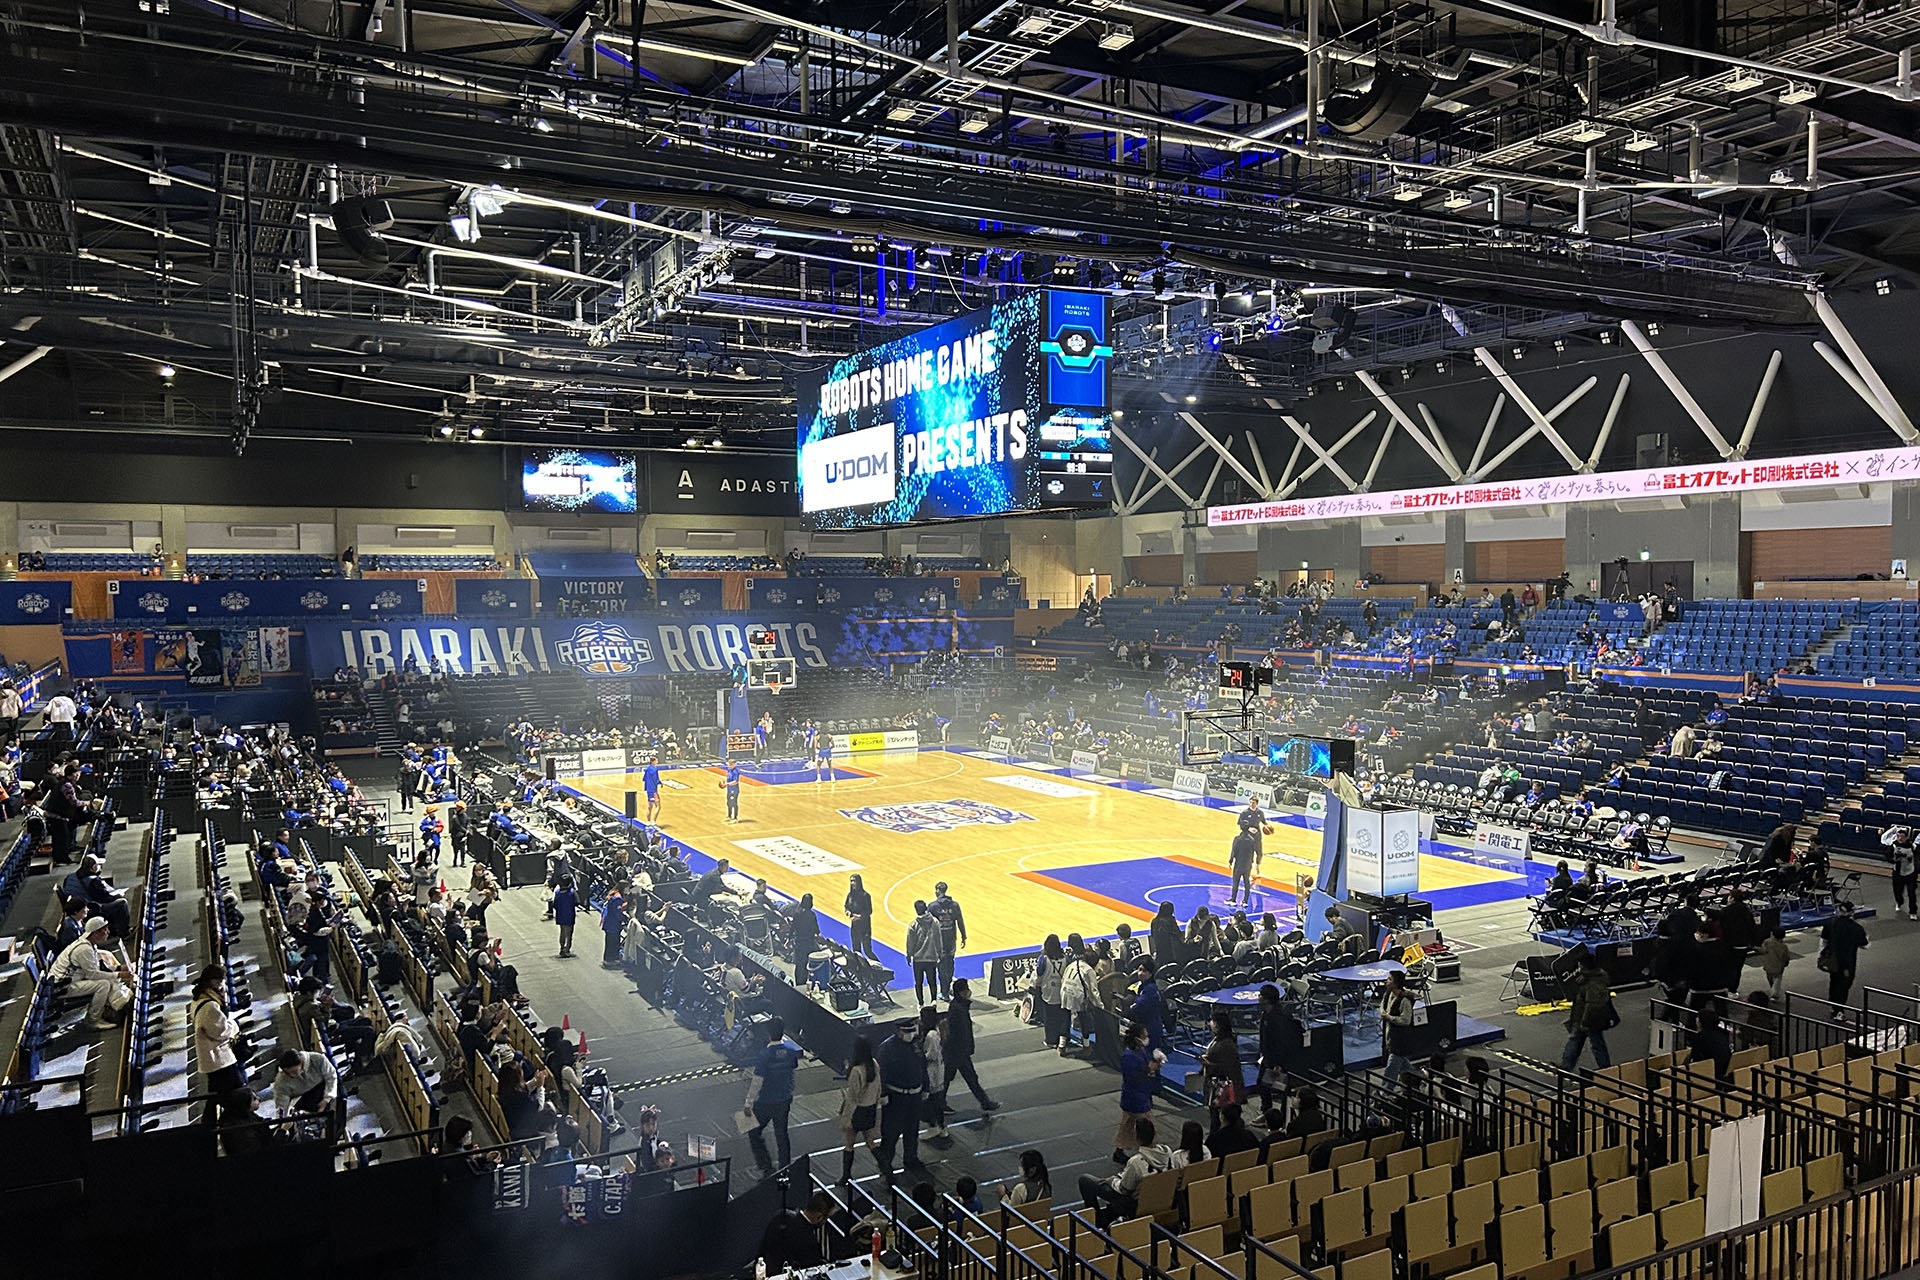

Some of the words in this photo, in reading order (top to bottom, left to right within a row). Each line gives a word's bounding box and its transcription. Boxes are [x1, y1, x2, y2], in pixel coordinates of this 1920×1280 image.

[820, 369, 881, 418] ROBOTS
[884, 350, 933, 401] HOME
[937, 329, 996, 385] GAME
[903, 409, 1028, 477] PRESENTS
[1894, 562, 1904, 574] A
[1455, 570, 1462, 580] A
[109, 583, 118, 592] B
[564, 581, 625, 595] VICTORY
[746, 580, 753, 588] B
[17, 599, 50, 608] ROBOTS
[138, 597, 169, 607] ROBOTS
[220, 597, 250, 606] ROBOTS
[300, 596, 329, 604] ROBOTS
[112, 632, 122, 642] 14
[764, 631, 776, 644] 24
[575, 640, 630, 648] IBARAKI
[341, 626, 551, 680] IBARAKI
[658, 622, 828, 672] ROBOTS
[558, 639, 652, 664] ROBOTS
[366, 656, 373, 665] L
[512, 653, 520, 661] K
[1231, 669, 1243, 687] 24
[1176, 774, 1203, 789] GLOBIS
[377, 812, 387, 821] M
[1488, 832, 1523, 851] 関電工
[400, 847, 409, 858] H
